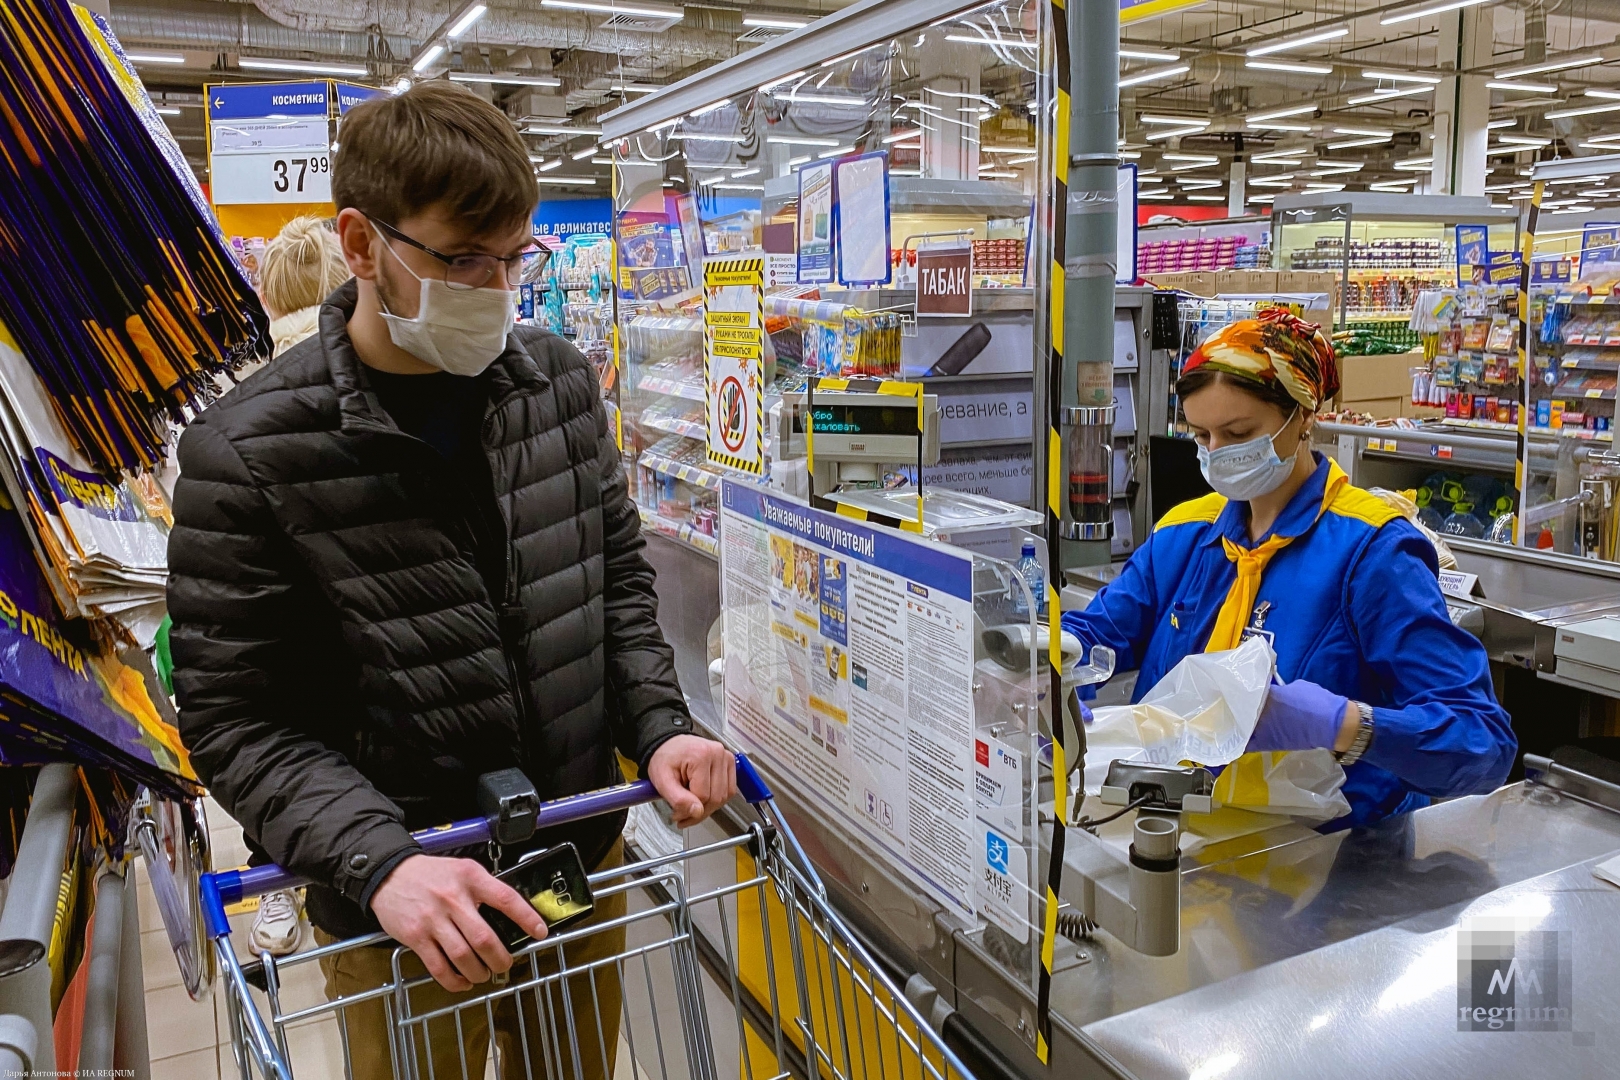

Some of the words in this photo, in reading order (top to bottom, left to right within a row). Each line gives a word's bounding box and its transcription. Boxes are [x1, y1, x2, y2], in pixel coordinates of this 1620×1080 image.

[272, 93, 324, 106] косметика
[553, 221, 611, 236] деликатес
[922, 266, 967, 296] ТАБАК
[1017, 401, 1027, 415] а
[804, 423, 861, 432] жаловать
[945, 471, 977, 483] всего,
[978, 467, 1019, 480] меньше
[762, 496, 812, 535] Уважаемые
[814, 520, 876, 559] покупатели!
[21, 611, 90, 682] ЛЕНТА
[1003, 753, 1017, 770] ВТБ
[975, 770, 1002, 790] ПРИНИМАЕМ
[979, 778, 996, 793] ОПЛАТЕ
[975, 783, 993, 798] БОНУСЫ
[984, 867, 1012, 898] 支付宝
[987, 885, 1010, 904] ALIPAY
